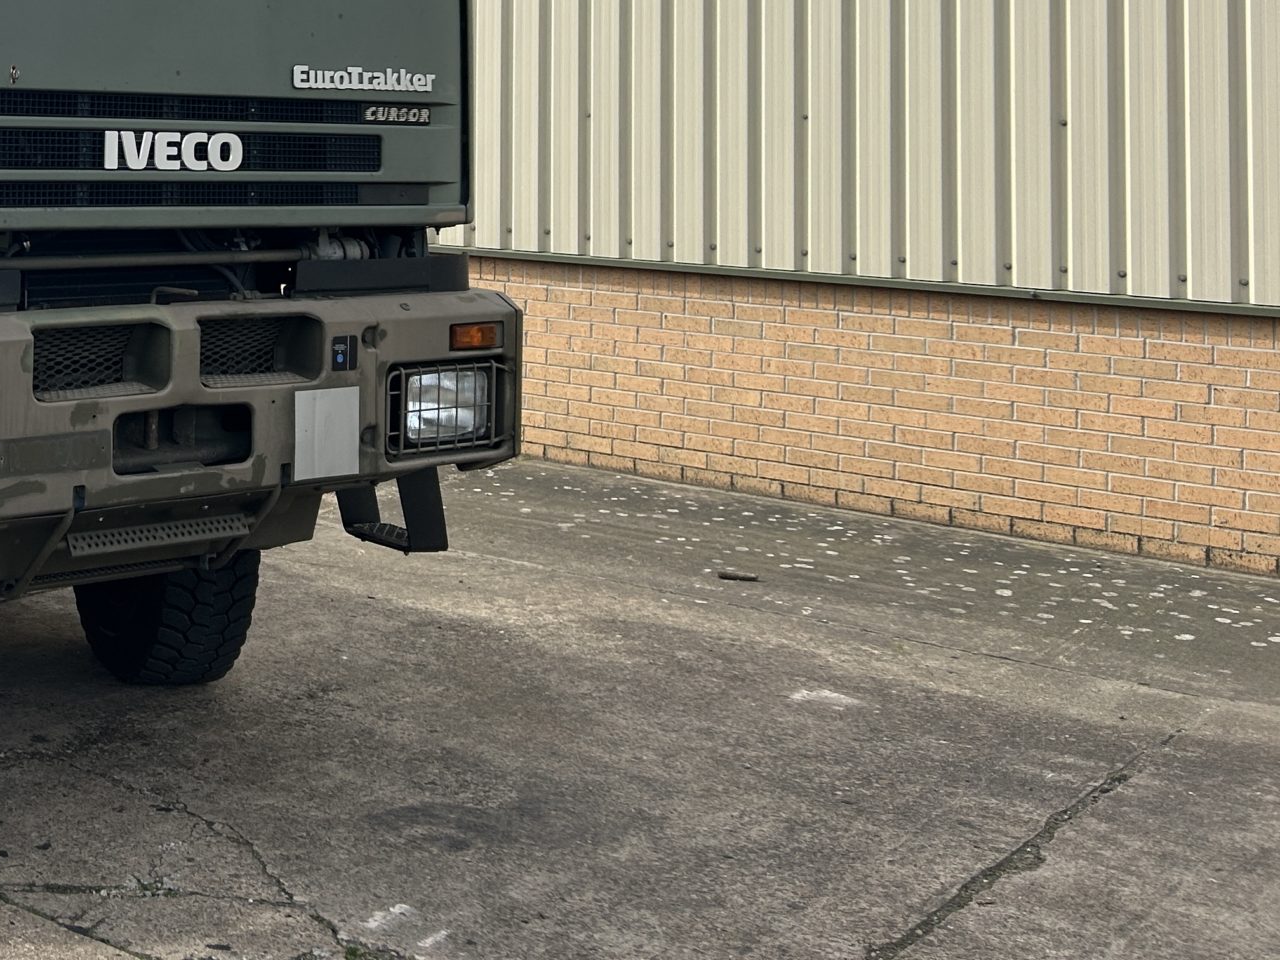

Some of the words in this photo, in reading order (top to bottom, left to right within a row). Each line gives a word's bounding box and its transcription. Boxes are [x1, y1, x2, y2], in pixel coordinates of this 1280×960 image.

[293, 65, 436, 92] EuroTrakker
[364, 106, 431, 123] CURSOR
[104, 130, 244, 171] IVECO
